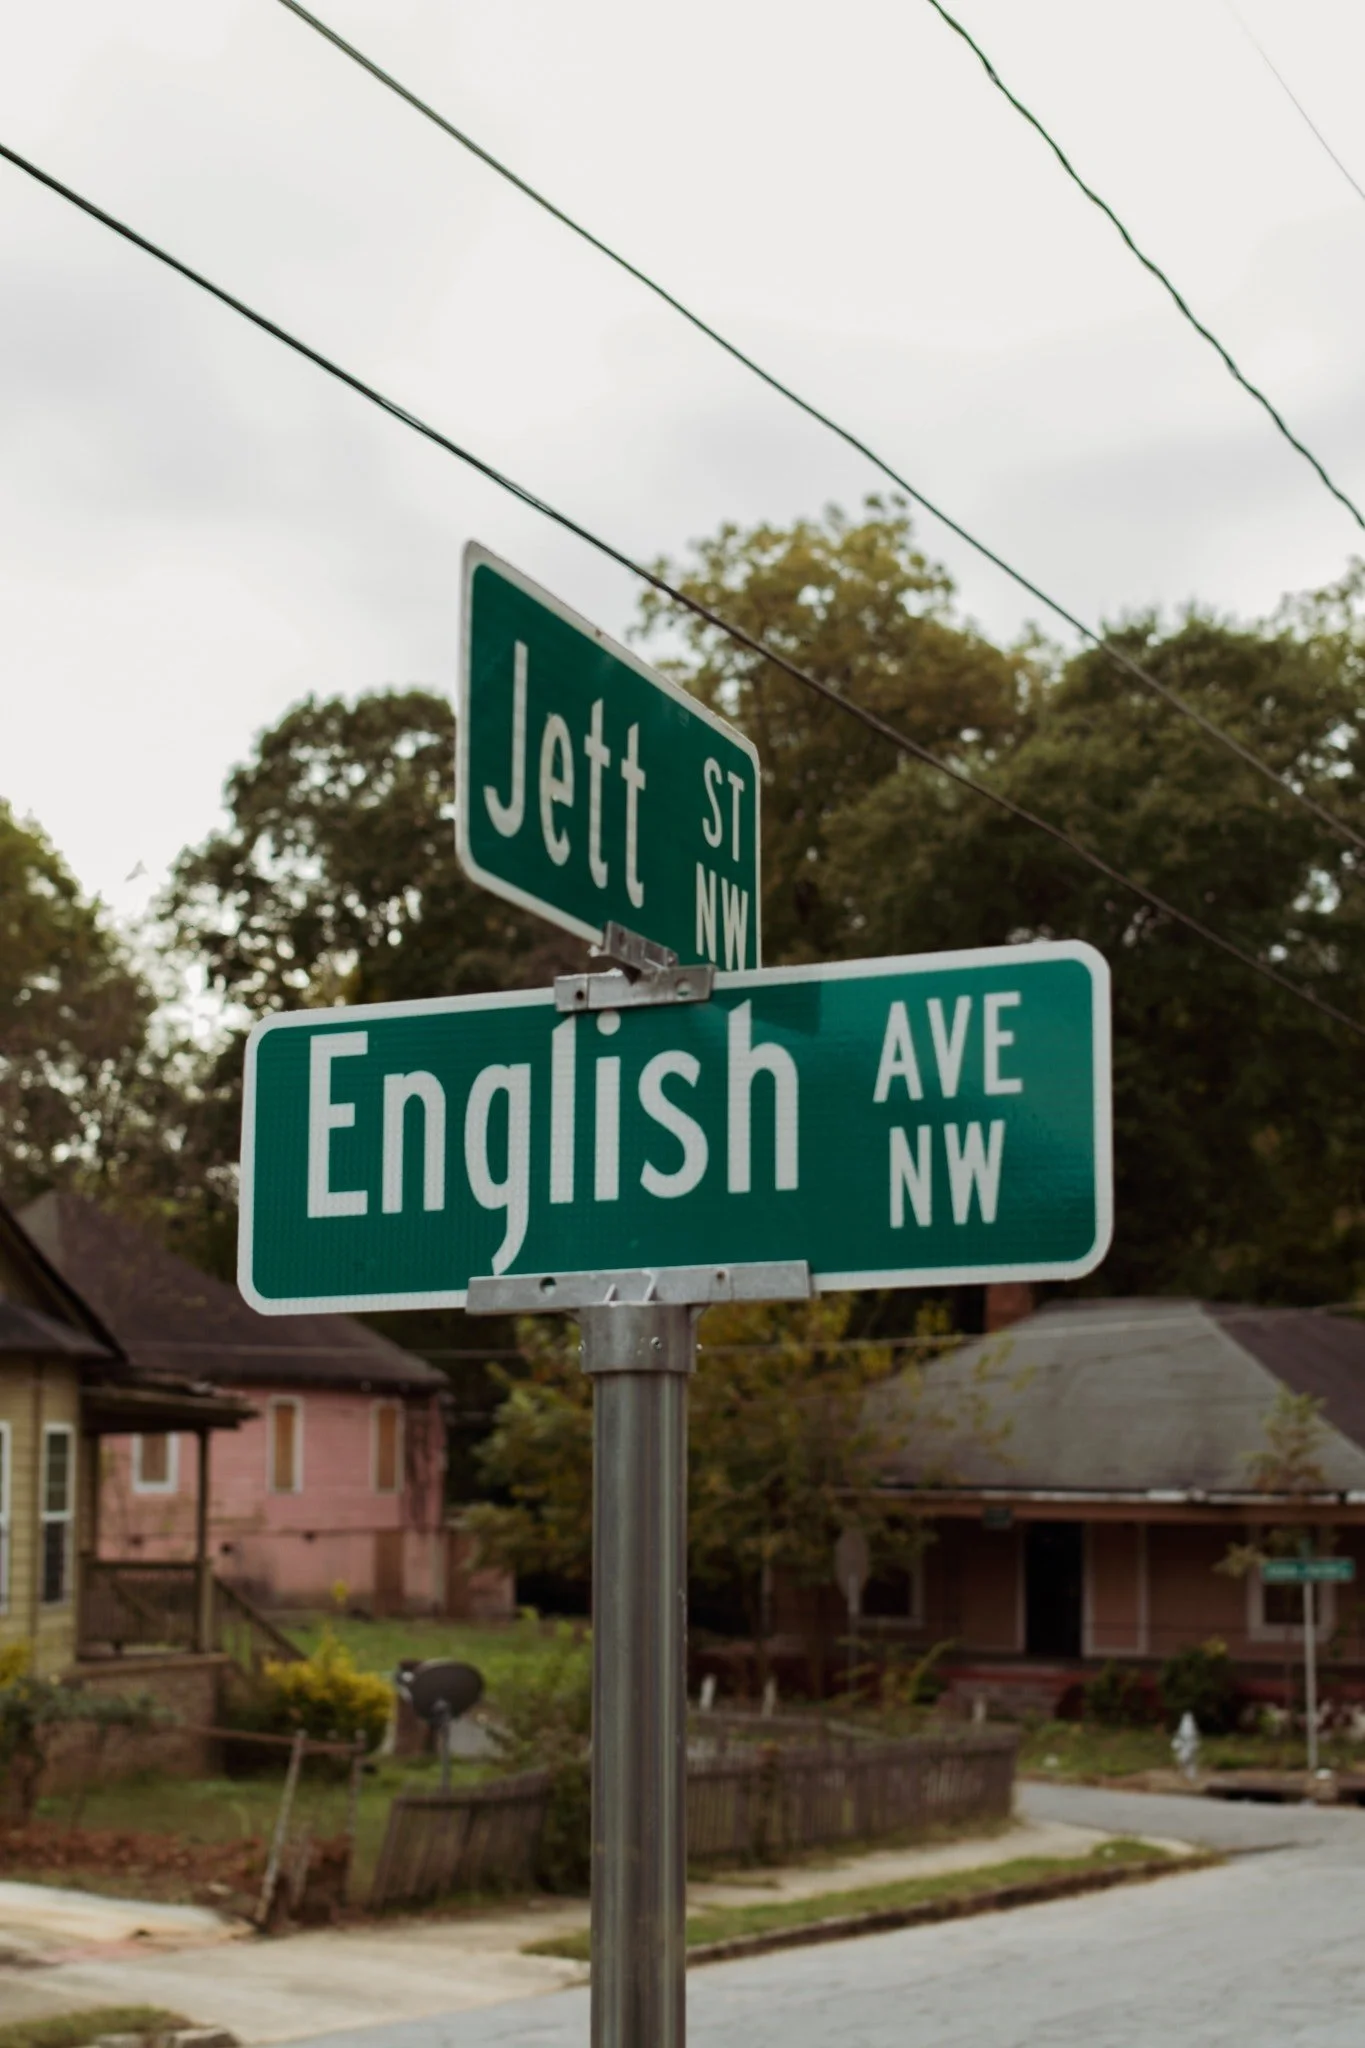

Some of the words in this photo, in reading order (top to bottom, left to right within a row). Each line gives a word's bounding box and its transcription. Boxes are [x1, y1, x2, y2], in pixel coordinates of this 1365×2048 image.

[484, 640, 646, 908] Jett
[702, 757, 744, 862] ST
[696, 862, 748, 972] NW
[874, 992, 1022, 1102] AVE
[306, 999, 798, 1274] English
[888, 1120, 1004, 1227] NW
